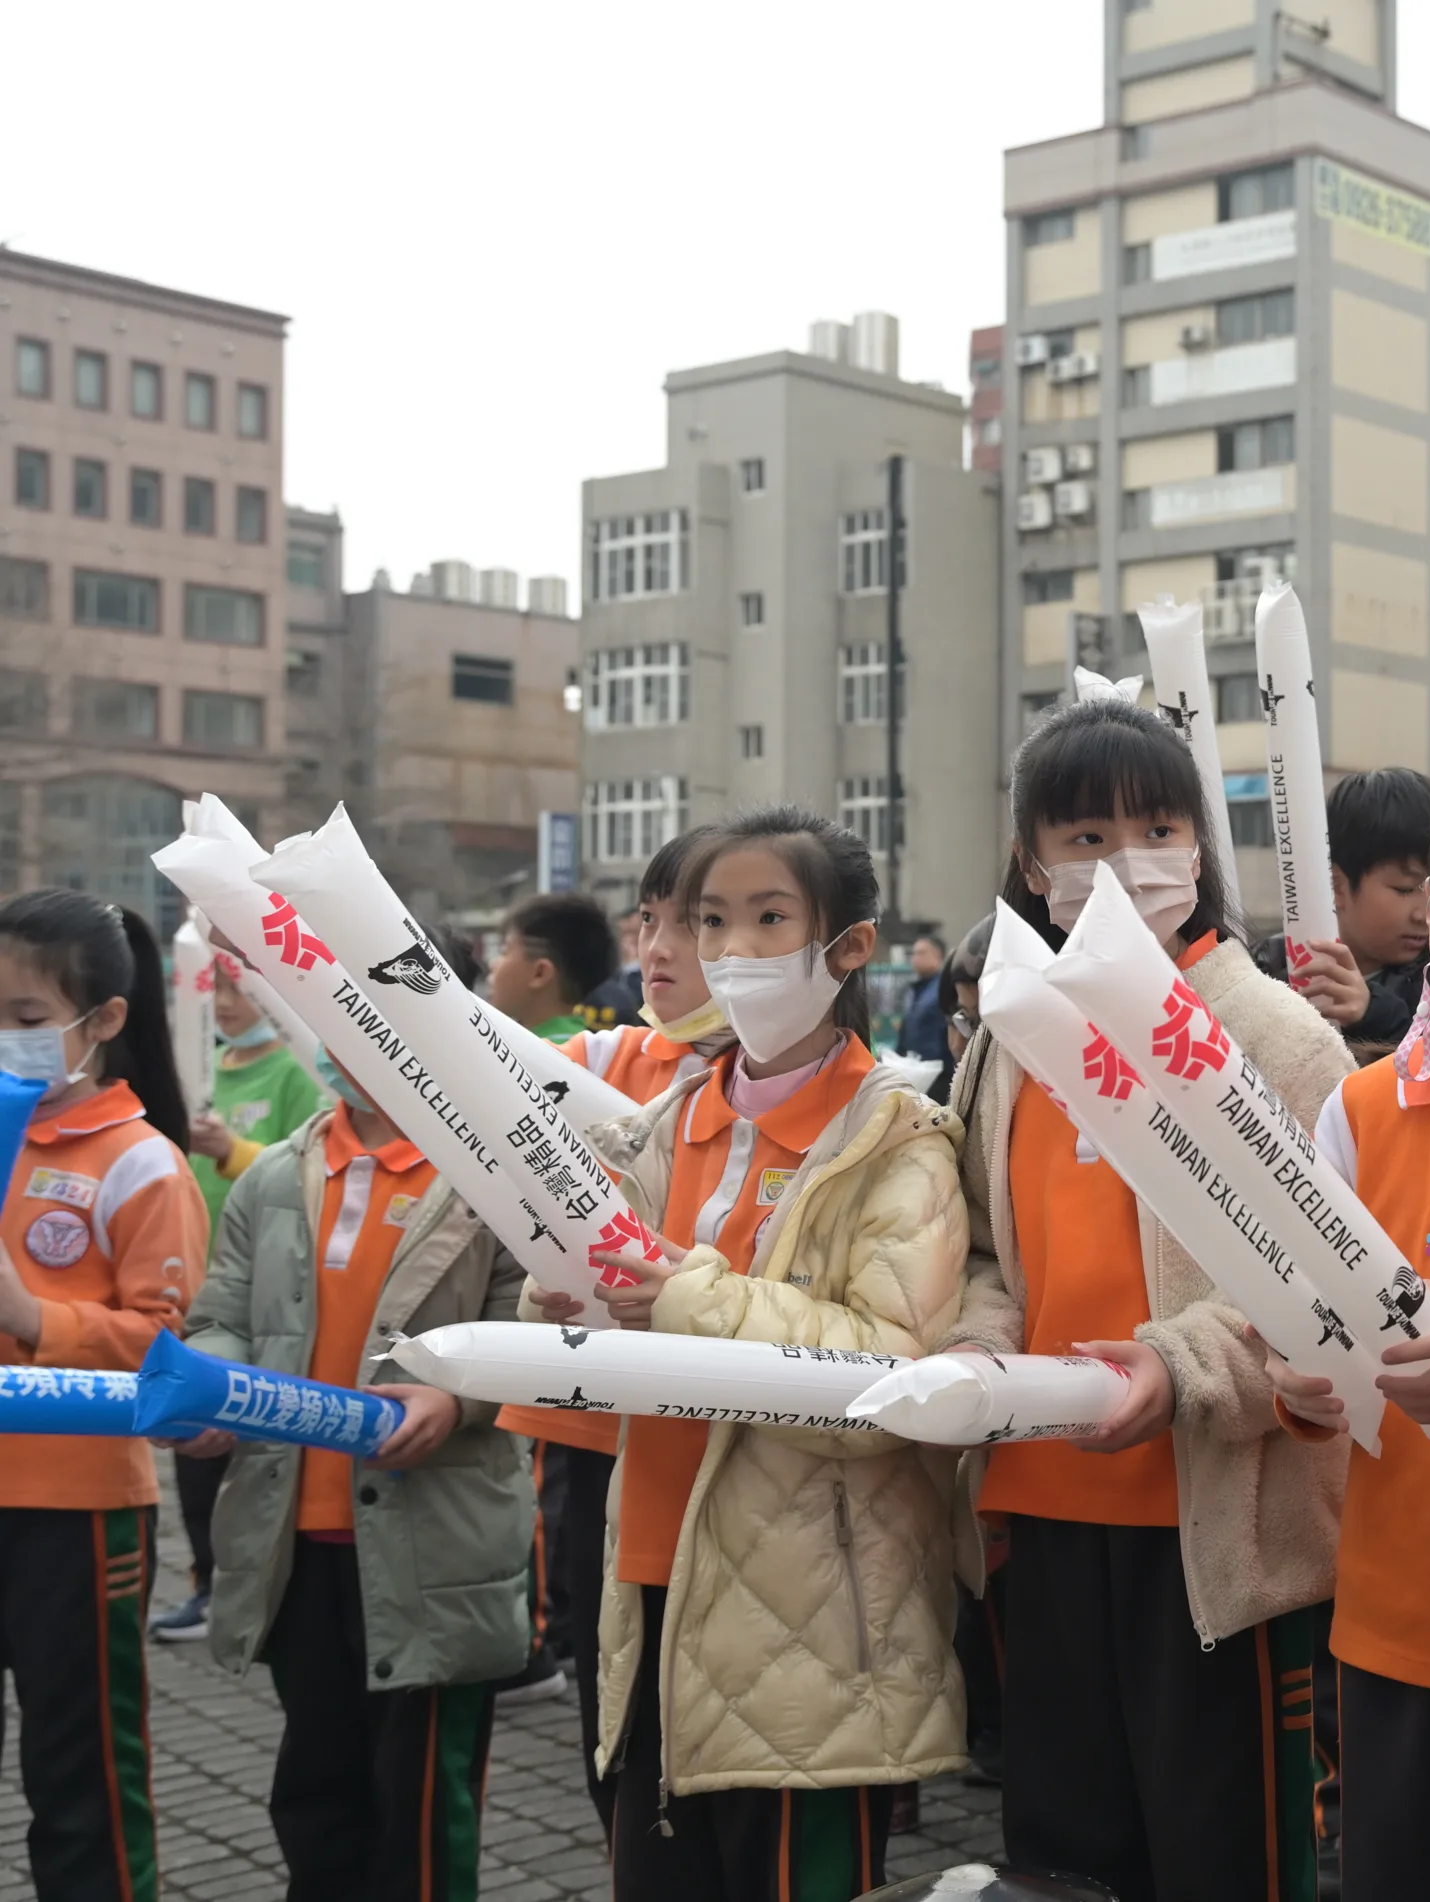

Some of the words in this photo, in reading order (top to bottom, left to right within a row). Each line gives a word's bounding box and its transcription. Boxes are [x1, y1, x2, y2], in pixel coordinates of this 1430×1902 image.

[1270, 753, 1292, 855] EXCELLENCE
[1282, 860, 1300, 924] TAIWAN
[332, 978, 408, 1061] TAIWAN
[398, 1056, 500, 1174] EXCELLENCE
[468, 1005, 558, 1127] EXCELLENCE
[505, 1113, 600, 1221] 台灣精品
[557, 1123, 613, 1199] TAIWAN
[1148, 1102, 1212, 1183] TAIWAN
[1206, 1173, 1297, 1284] EXCELLENCE
[1216, 1085, 1284, 1167] TAIWAN
[1273, 1158, 1369, 1271] EXCELLENCE
[655, 1403, 801, 1426] EXCELLENCE
